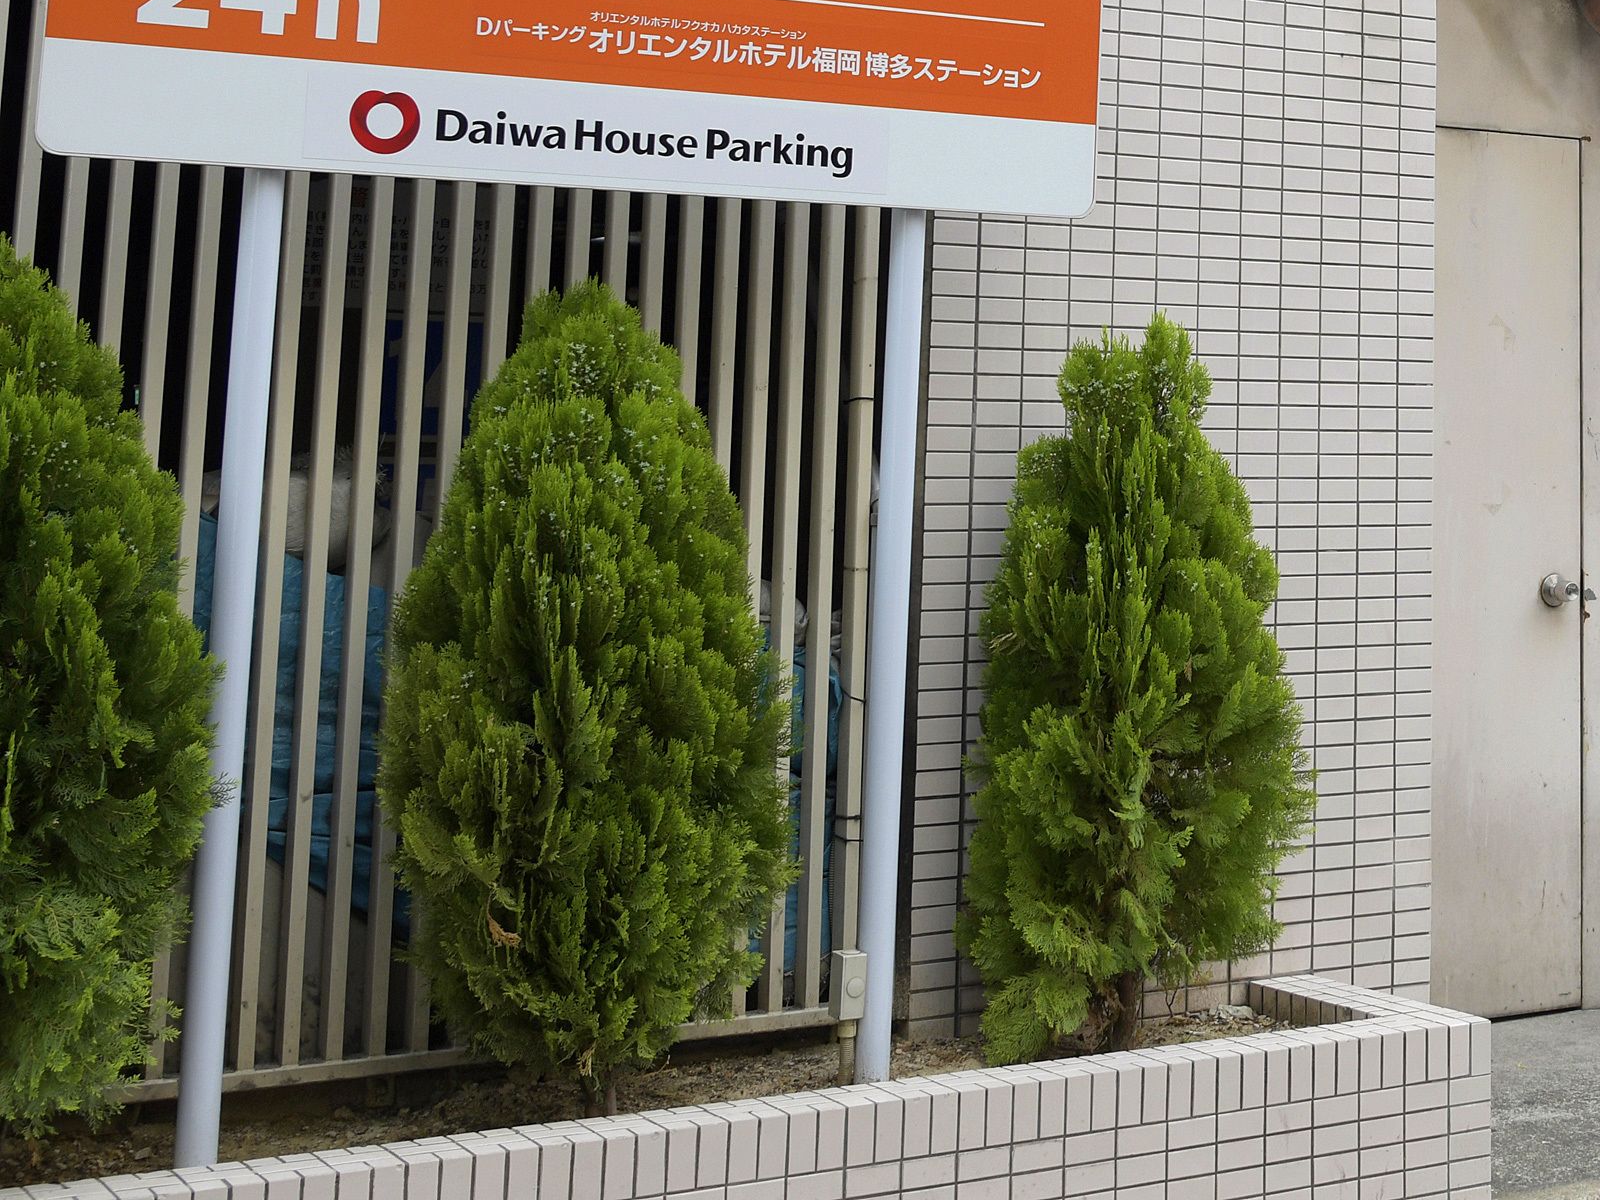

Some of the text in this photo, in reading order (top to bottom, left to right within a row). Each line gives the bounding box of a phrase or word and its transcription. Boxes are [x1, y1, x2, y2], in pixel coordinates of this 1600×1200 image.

[436, 109, 854, 177] Daiwa House Parking
